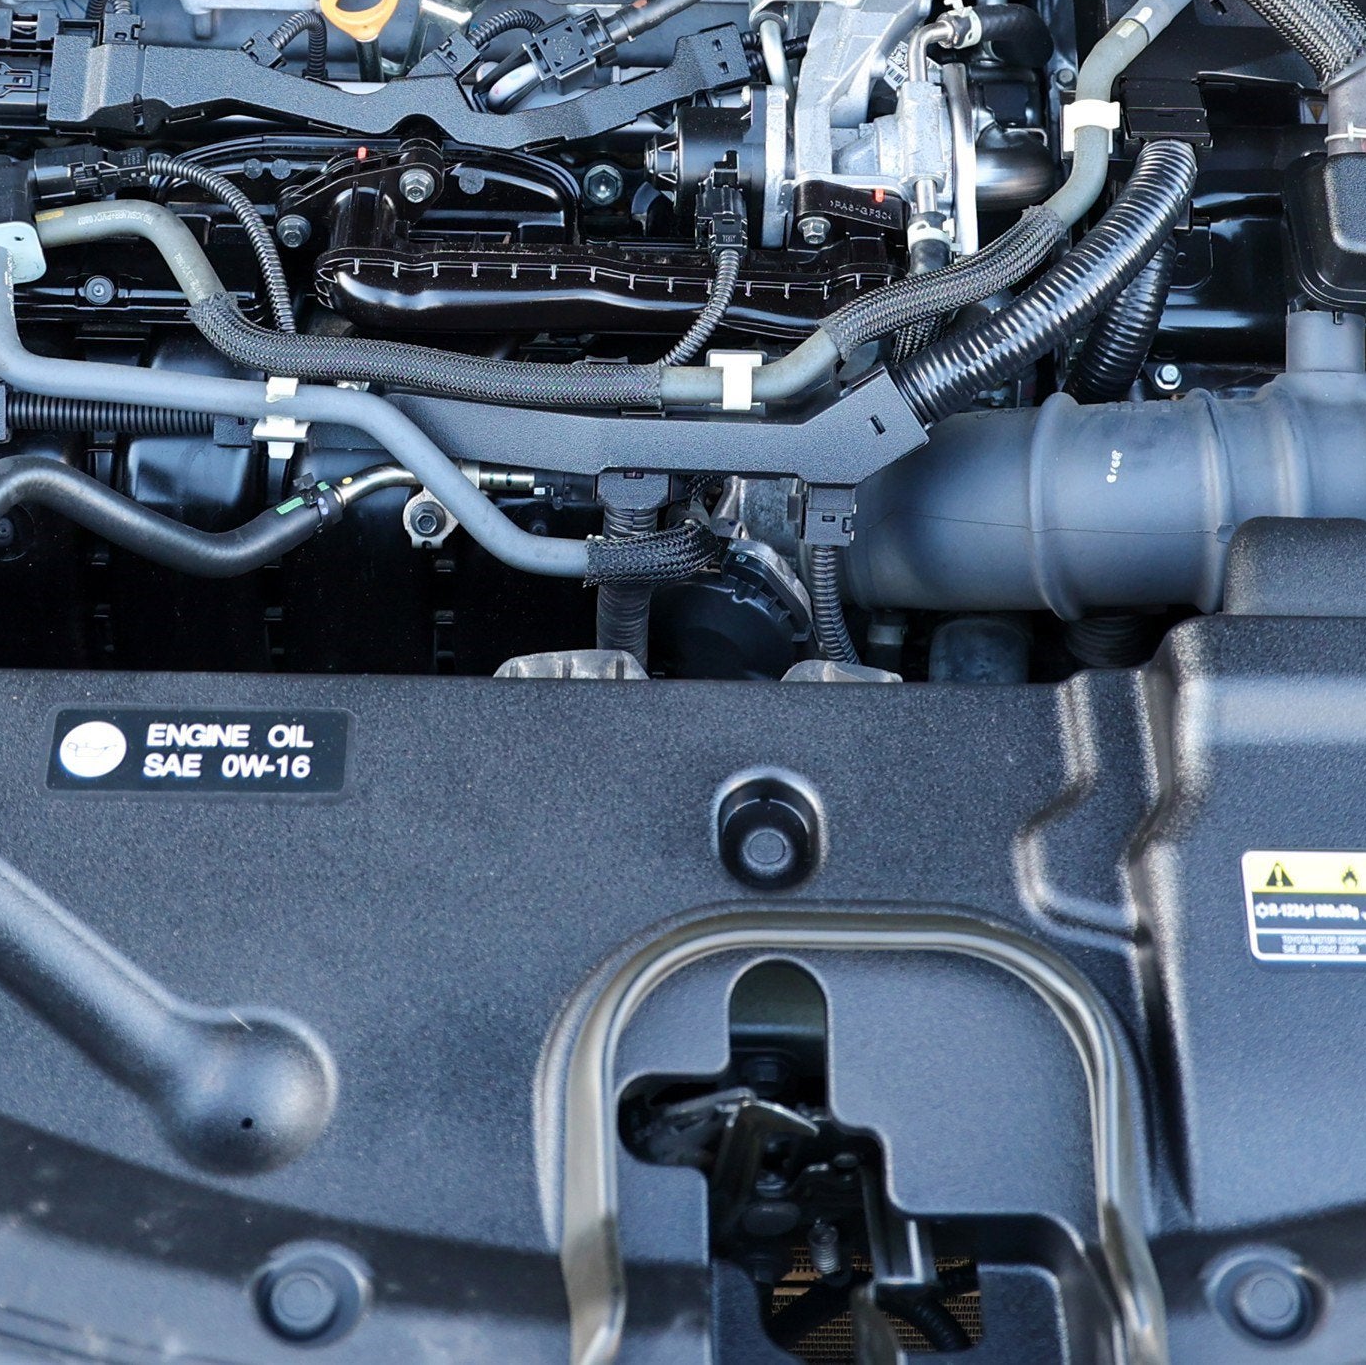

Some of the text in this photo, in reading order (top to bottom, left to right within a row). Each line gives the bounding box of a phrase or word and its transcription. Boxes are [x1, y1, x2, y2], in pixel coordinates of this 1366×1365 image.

[146, 723, 313, 748] ENGINE OIL
[143, 754, 311, 778] SAE 0W-16
